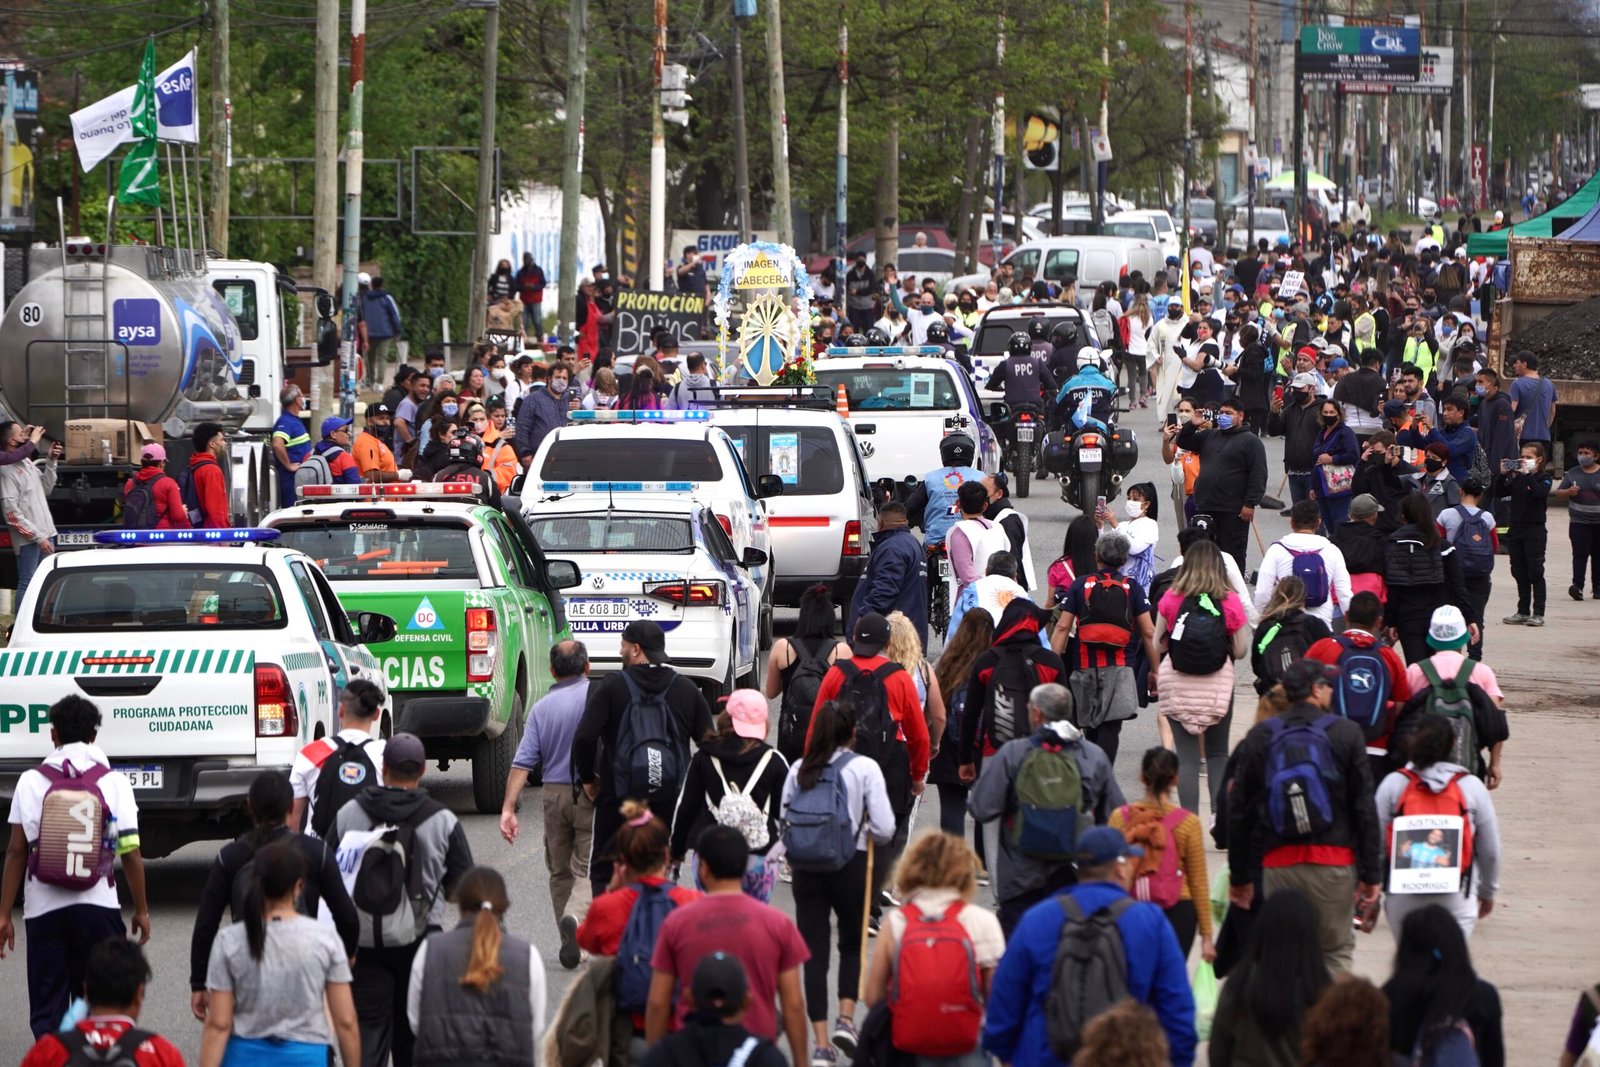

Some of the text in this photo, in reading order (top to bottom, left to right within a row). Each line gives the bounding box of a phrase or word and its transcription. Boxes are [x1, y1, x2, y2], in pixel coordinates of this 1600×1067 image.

[1317, 28, 1337, 41] DOG
[1317, 40, 1343, 50] CHOW
[160, 73, 191, 94] aysa
[744, 259, 779, 268] IMAGEN
[736, 274, 789, 286] CABECERA
[23, 306, 41, 323] 80
[118, 325, 156, 341] aysa
[1014, 363, 1033, 377] PPC
[59, 534, 90, 544] AE 820
[572, 604, 626, 615] AE 608 DQ
[418, 613, 434, 623] DC
[568, 622, 630, 631] RULLA URBA
[395, 634, 453, 642] DEFENSA CIVIL
[380, 656, 446, 689] CIAS
[113, 704, 248, 719] PROGRAMA PROTECCION
[149, 720, 214, 733] CIUDADANA
[647, 746, 662, 787] NIKE
[142, 772, 159, 787] PL
[66, 799, 95, 878] FILA
